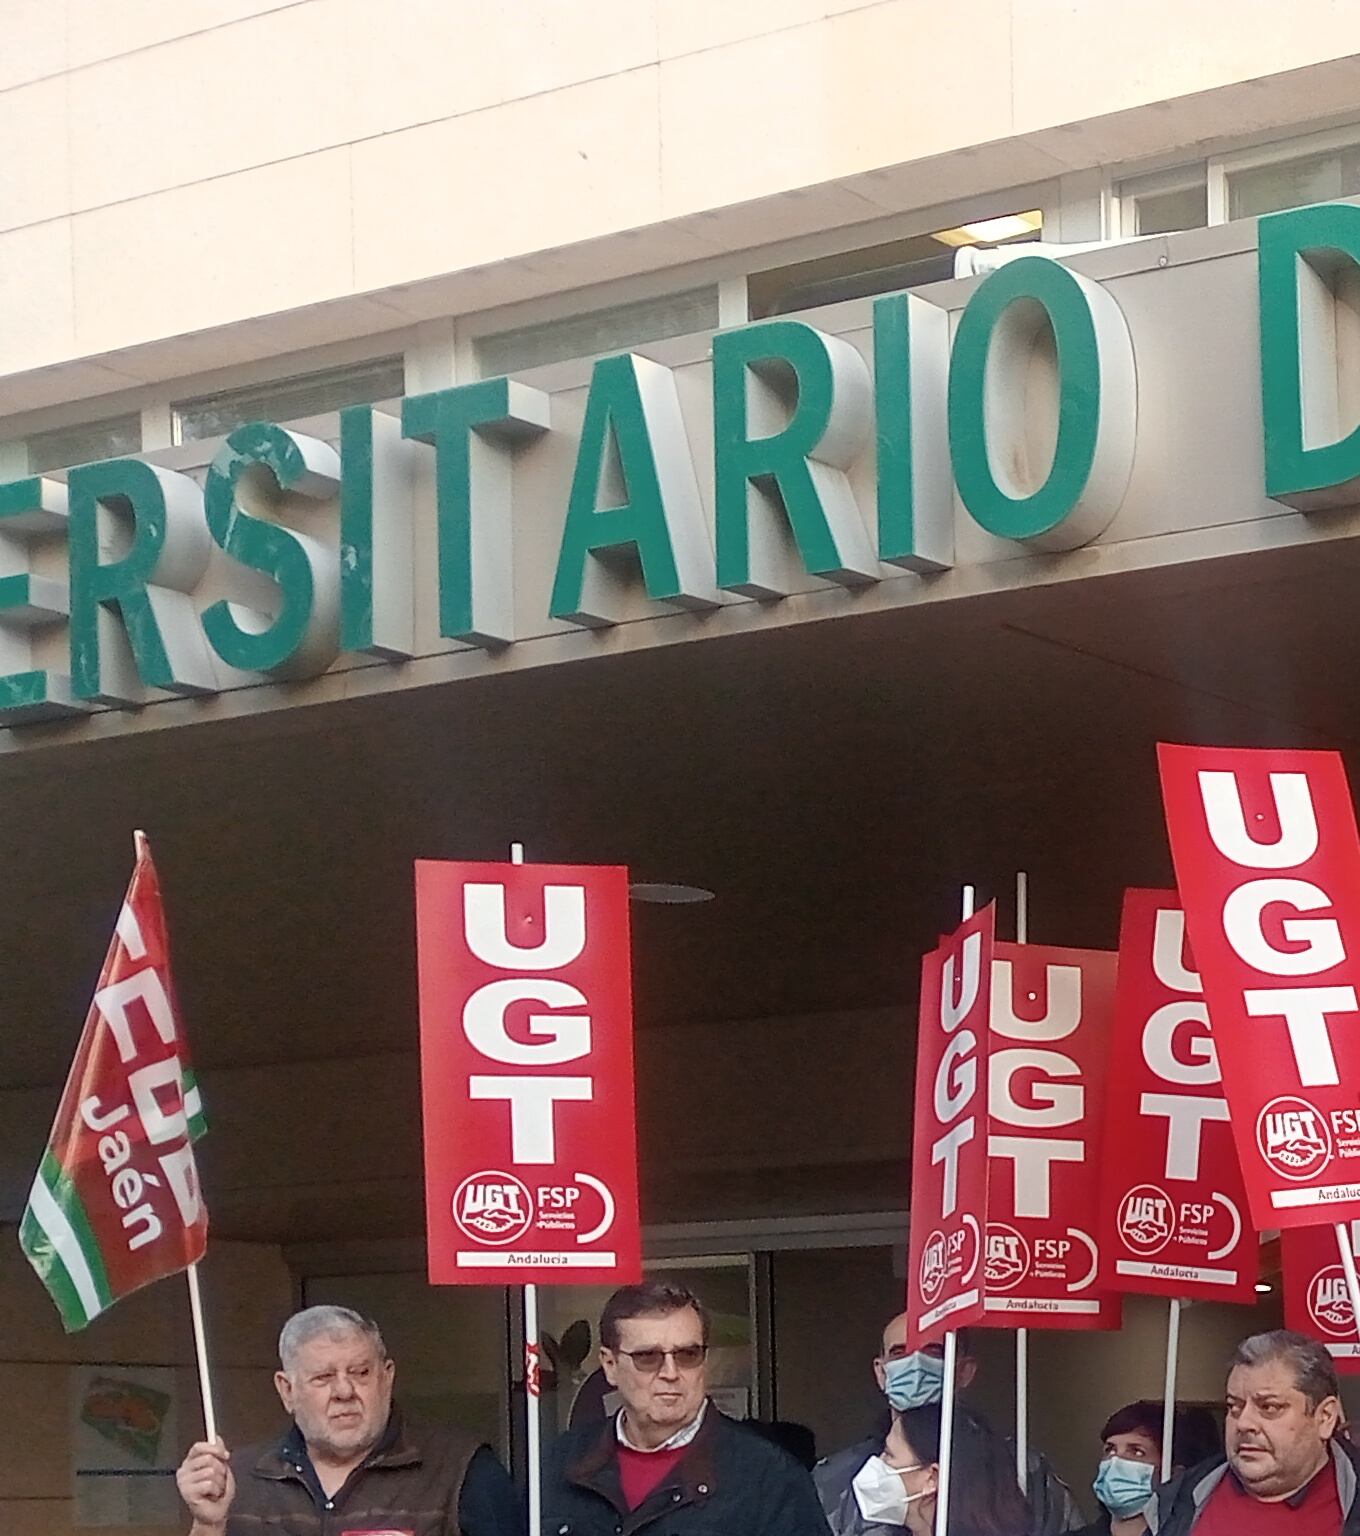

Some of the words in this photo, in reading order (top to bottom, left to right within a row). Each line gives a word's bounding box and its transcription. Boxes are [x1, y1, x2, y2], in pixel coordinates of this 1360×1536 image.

[1198, 770, 1358, 1087] UGT
[462, 883, 593, 1165] UGT
[932, 931, 982, 1220] UGT
[988, 959, 1085, 1219] UGT
[1265, 1110, 1318, 1146] UGT
[79, 1095, 163, 1252] Jaén
[465, 1184, 521, 1212] UGT
[537, 1187, 580, 1208] FSP
[1125, 1196, 1167, 1225] UGT
[1180, 1203, 1215, 1224] FSP
[507, 1254, 569, 1264] Andalucía
[1034, 1239, 1071, 1259] FSP
[1317, 1278, 1348, 1306] UG
